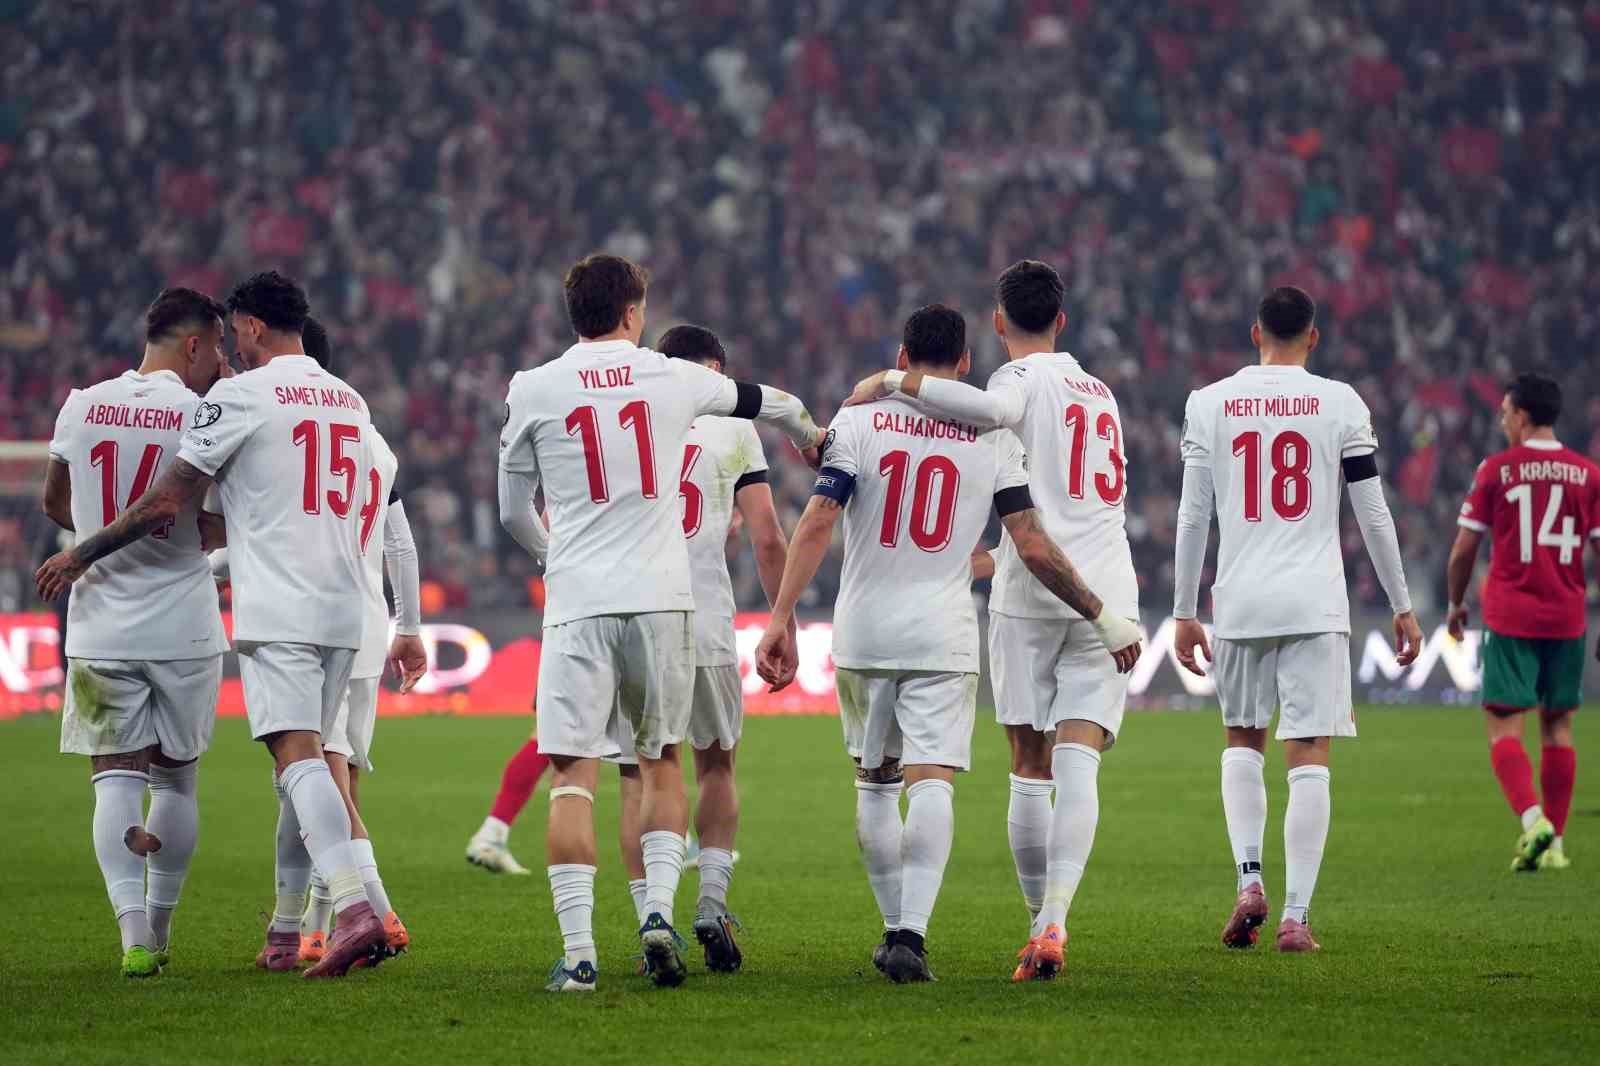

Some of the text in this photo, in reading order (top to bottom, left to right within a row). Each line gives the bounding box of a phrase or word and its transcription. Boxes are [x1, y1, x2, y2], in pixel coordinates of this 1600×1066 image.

[275, 386, 318, 406] SAMET
[578, 366, 634, 389] YILDIZ
[1224, 393, 1320, 417] MERT MÜLDÜR
[84, 402, 184, 432] ABDÜLKERİM
[873, 411, 978, 443] ÇALHANOĞLU
[292, 419, 361, 520] 15
[565, 400, 658, 504] 11
[1065, 403, 1124, 507] 13
[1232, 430, 1312, 522] 18
[1500, 460, 1589, 486] F. KRASTEV
[879, 449, 961, 553] 10
[1504, 483, 1582, 565] 14
